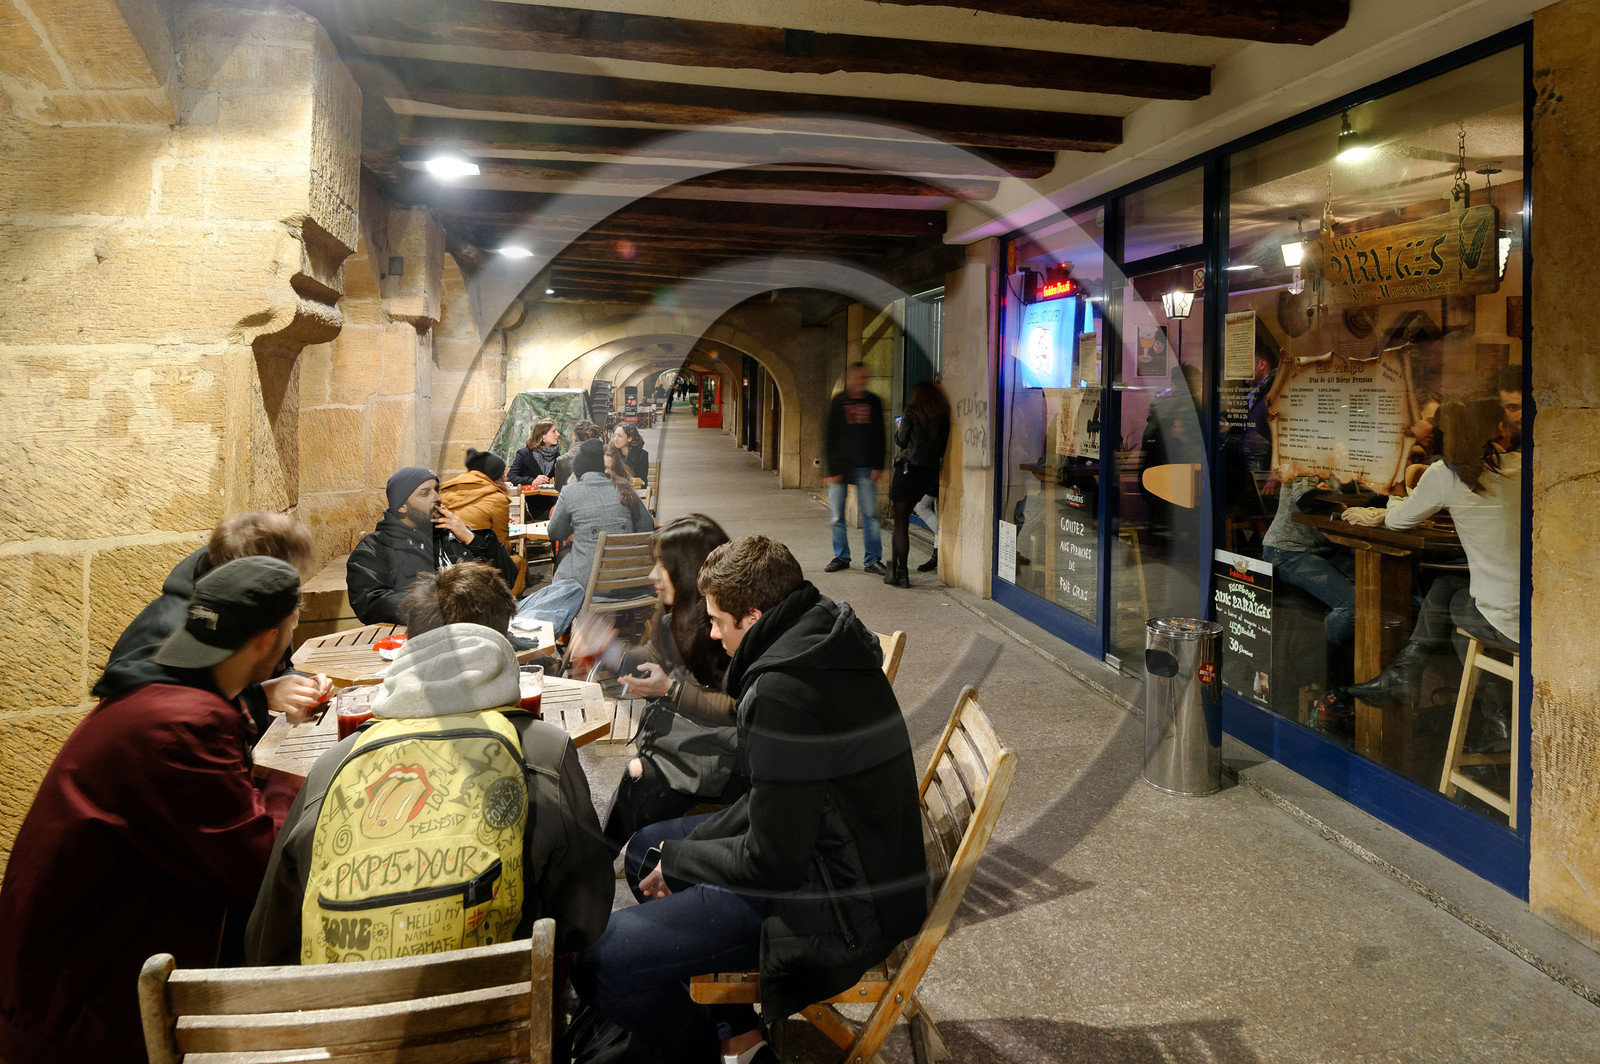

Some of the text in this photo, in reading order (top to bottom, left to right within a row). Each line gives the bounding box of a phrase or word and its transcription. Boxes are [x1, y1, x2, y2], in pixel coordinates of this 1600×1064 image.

[1229, 637, 1239, 652] 30
[406, 906, 460, 930] HELLO MY
[405, 928, 435, 942] NAME
